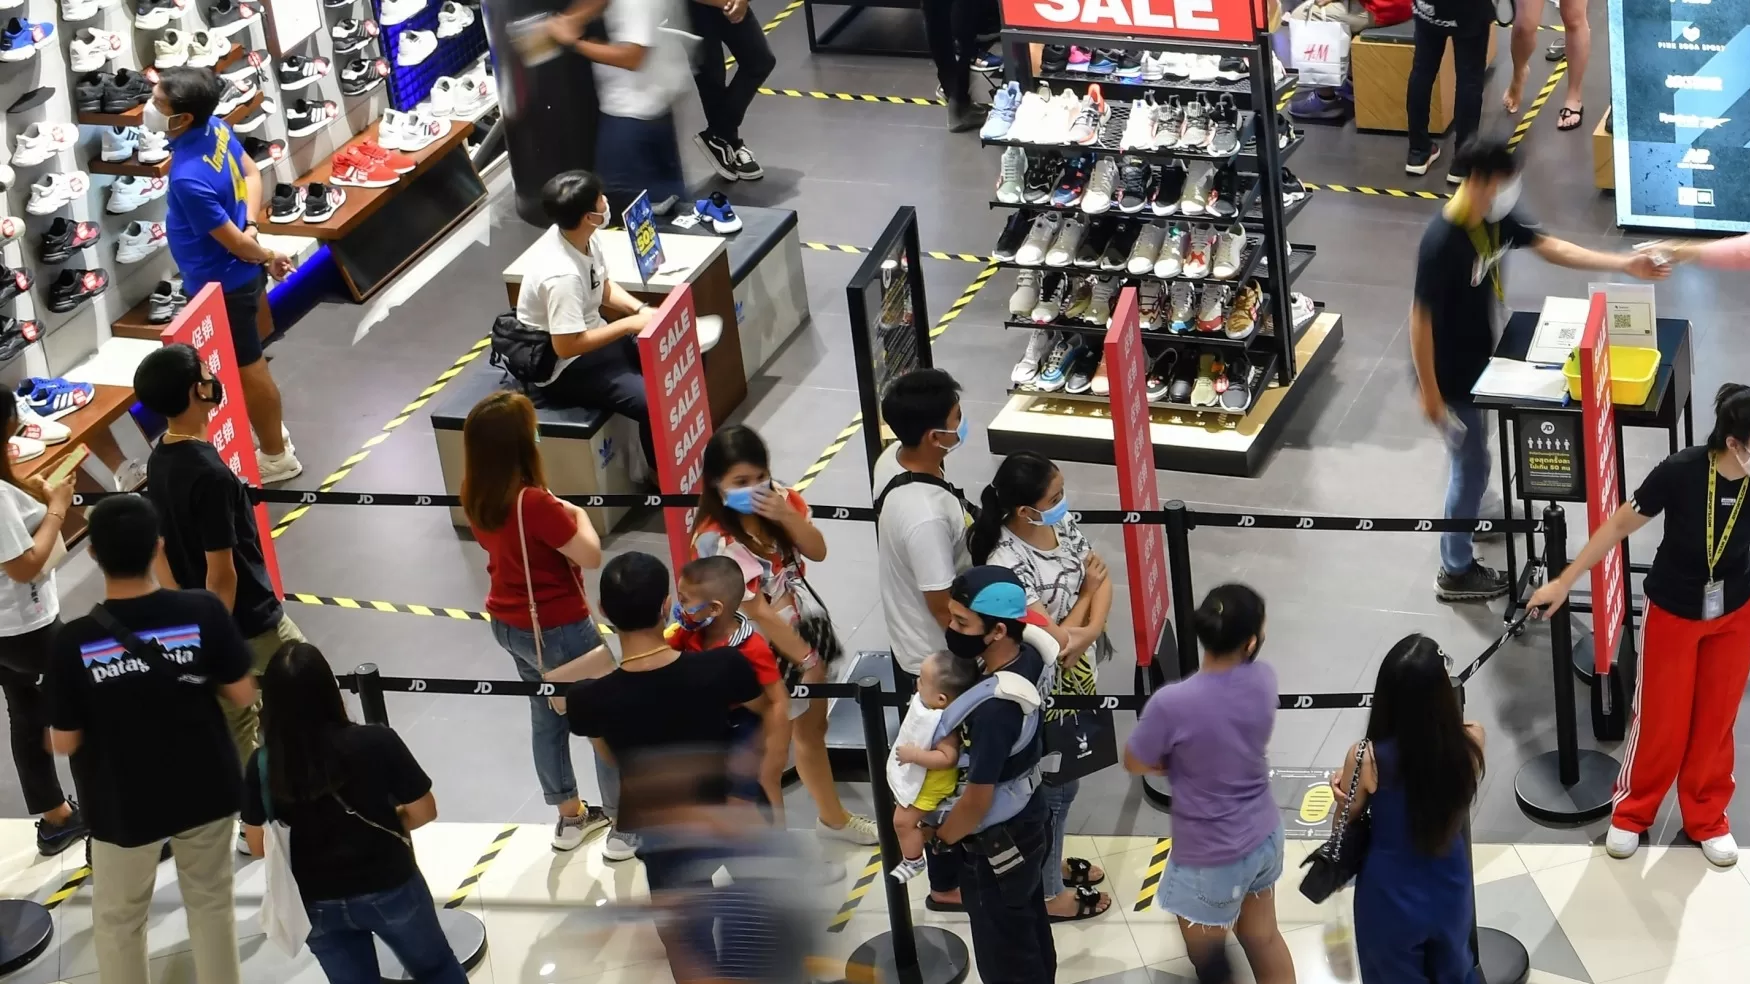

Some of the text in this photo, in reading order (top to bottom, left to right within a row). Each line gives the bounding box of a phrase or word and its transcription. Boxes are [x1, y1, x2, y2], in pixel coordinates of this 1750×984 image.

[191, 315, 215, 351] 促销
[658, 307, 691, 362] SALE
[664, 341, 696, 397] SALE
[669, 376, 701, 431] SALE
[1597, 388, 1612, 443] SALE
[213, 418, 235, 453] 促销
[674, 410, 706, 466] SALE
[1599, 422, 1614, 478] SALE
[1601, 457, 1616, 512] SALE
[300, 492, 317, 503] JD
[357, 494, 374, 504] JD
[415, 495, 431, 505] JD
[587, 496, 603, 506] JD
[645, 496, 661, 506] JD
[833, 508, 849, 519] JD
[1123, 512, 1140, 523] JD
[1238, 516, 1255, 527] JD
[1296, 518, 1313, 529] JD
[1356, 519, 1373, 530] JD
[1415, 520, 1432, 531] JD
[1475, 521, 1492, 532] JD
[1606, 556, 1620, 614] SALE
[1608, 588, 1622, 647] SALE
[91, 648, 194, 684] patagnia
[408, 679, 426, 692] JD
[474, 681, 492, 694] JD
[537, 684, 555, 696] JD
[790, 686, 809, 698] JD
[1100, 697, 1118, 709] JD
[1294, 696, 1312, 708] JD
